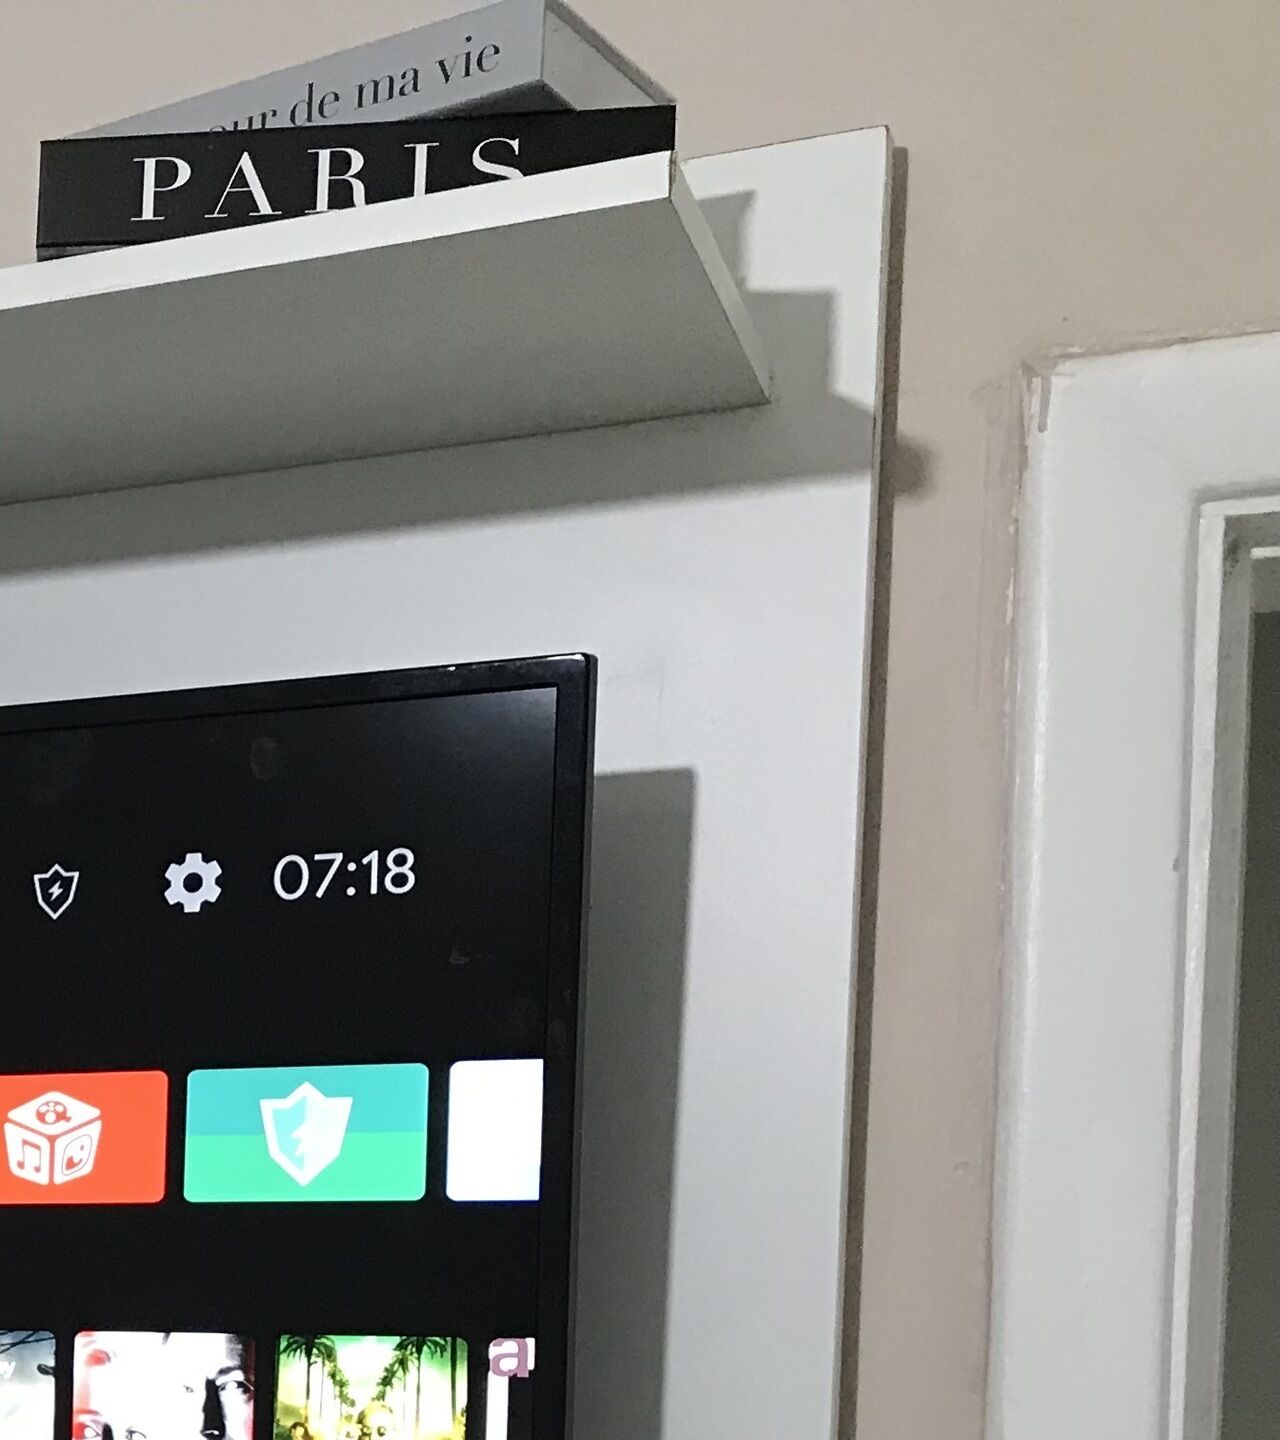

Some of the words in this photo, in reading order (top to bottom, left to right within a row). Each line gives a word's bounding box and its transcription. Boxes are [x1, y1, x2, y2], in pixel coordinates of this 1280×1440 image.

[289, 81, 341, 127] de
[353, 67, 421, 111] ma
[434, 34, 501, 85] vie
[129, 135, 528, 222] PARIS
[273, 847, 416, 900] 07:18
